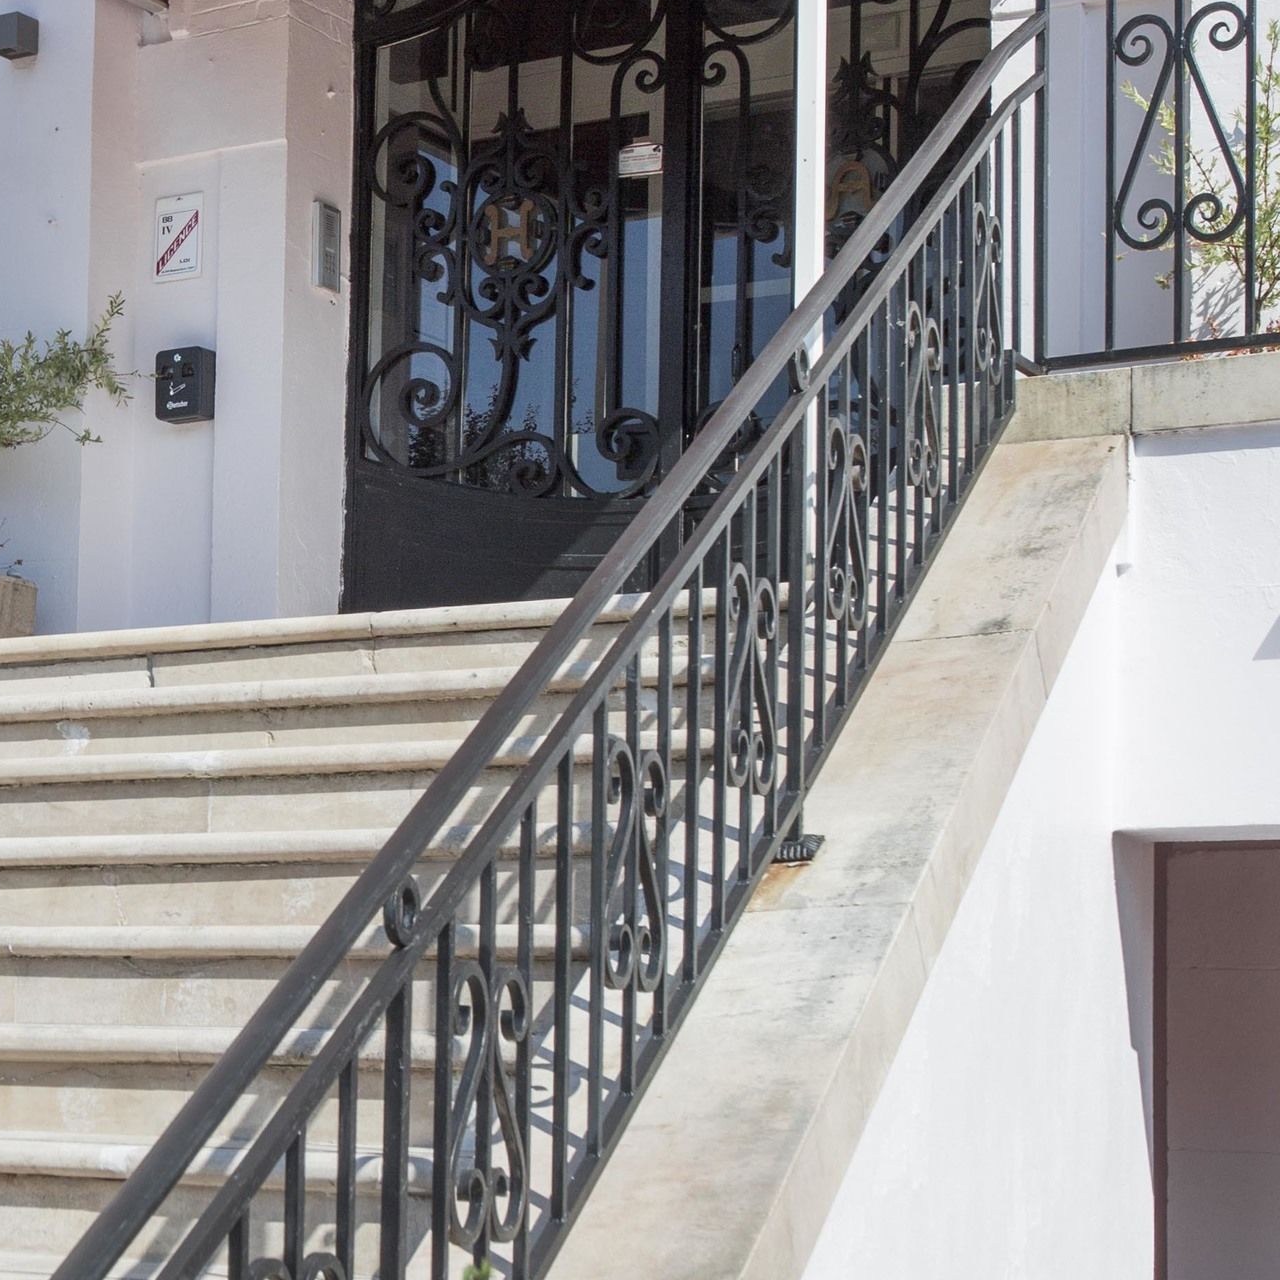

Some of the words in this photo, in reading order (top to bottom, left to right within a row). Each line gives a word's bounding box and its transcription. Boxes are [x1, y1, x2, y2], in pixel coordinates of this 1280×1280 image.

[158, 214, 198, 271] LICENCE
[162, 225, 173, 235] IV
[484, 199, 534, 265] H
